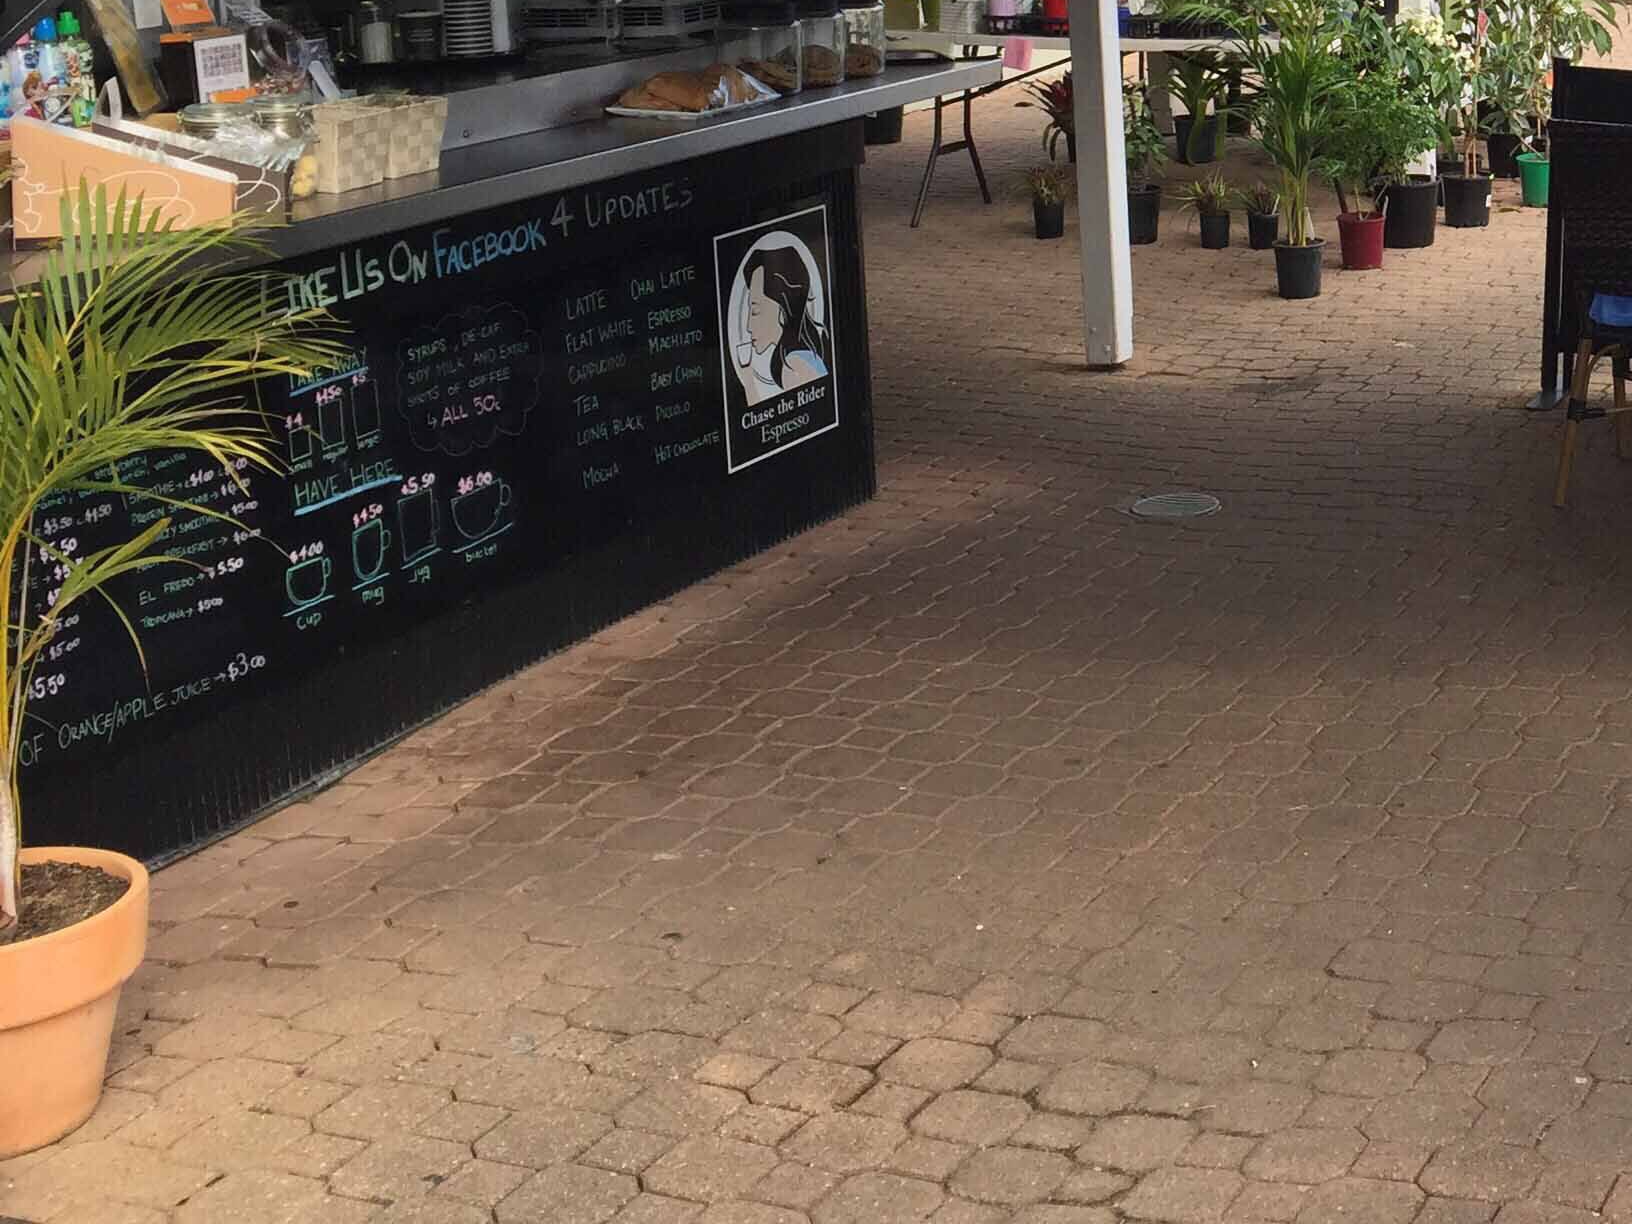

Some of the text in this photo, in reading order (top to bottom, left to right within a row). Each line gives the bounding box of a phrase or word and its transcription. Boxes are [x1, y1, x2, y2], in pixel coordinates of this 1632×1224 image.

[433, 219, 546, 278] FACEBOOK
[551, 197, 575, 237] 4
[585, 177, 695, 228] UPDATES
[660, 265, 697, 290] LATTE
[566, 289, 608, 320] LATTE
[648, 305, 693, 329] ESPRESSO
[565, 319, 636, 353] FLAT WHITE
[441, 405, 469, 426] ALL
[573, 394, 600, 417] TEA
[742, 385, 826, 429] Chase the Rider
[577, 416, 645, 447] LONG BLACK
[761, 413, 810, 443] Espresso
[294, 458, 395, 506] HAVE HERE
[139, 590, 157, 606] EL
[362, 586, 385, 606] mug
[171, 677, 212, 706] JUICE
